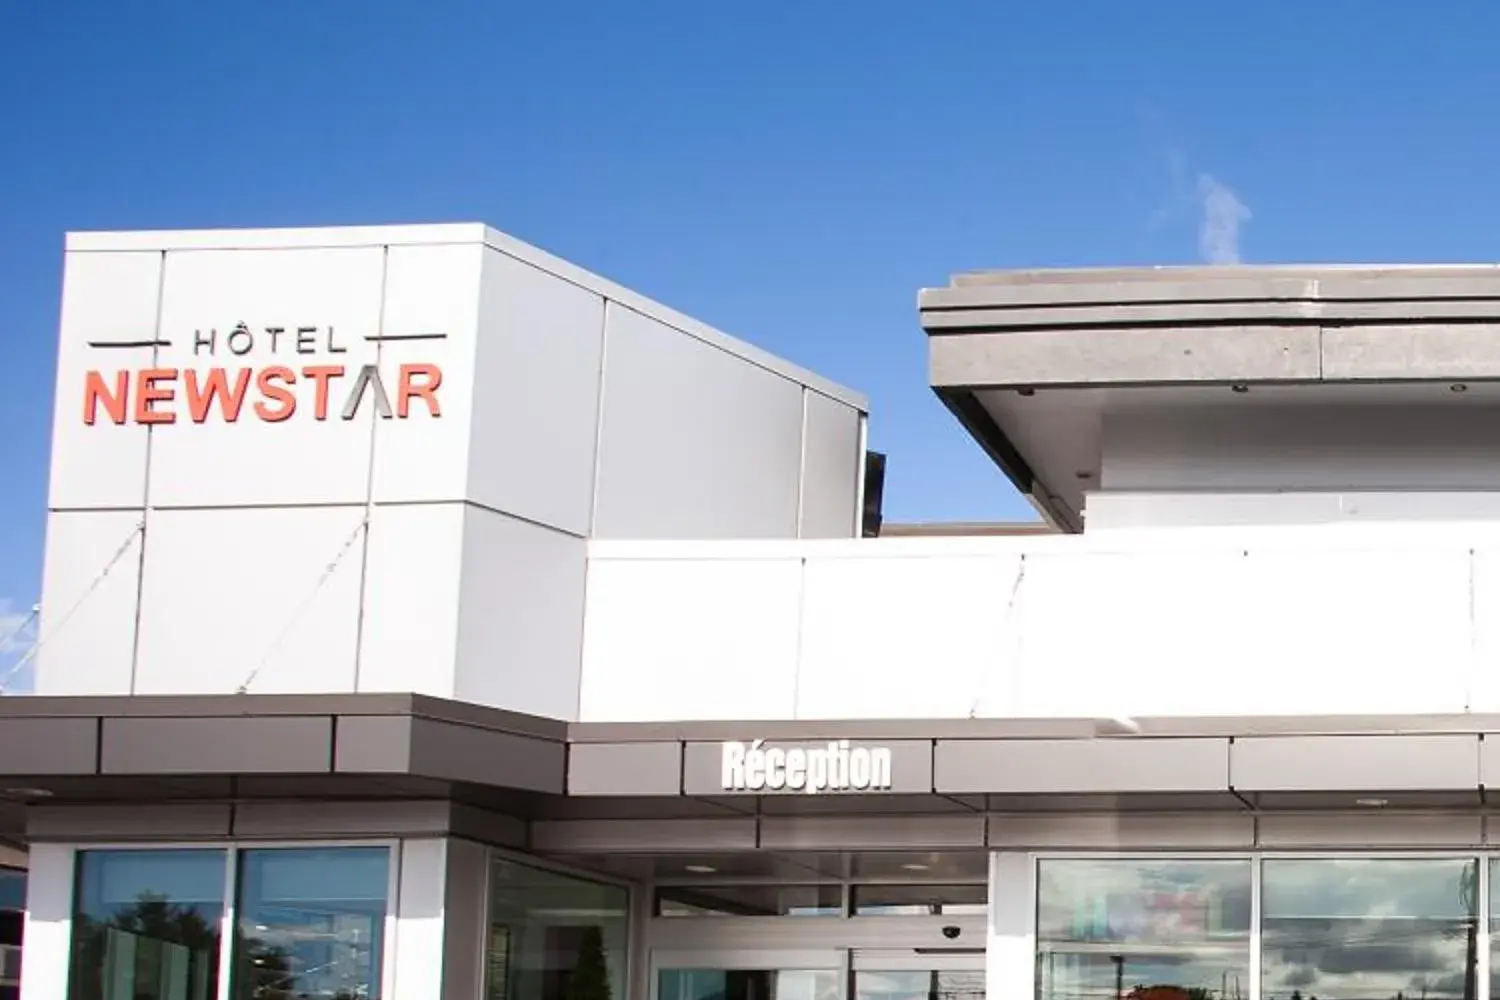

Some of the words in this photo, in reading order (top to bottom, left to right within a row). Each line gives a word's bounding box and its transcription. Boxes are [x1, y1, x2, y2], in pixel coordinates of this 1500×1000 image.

[193, 321, 347, 355] HÔTEL
[83, 363, 443, 425] NEWSTAR
[722, 738, 892, 794] Réception
